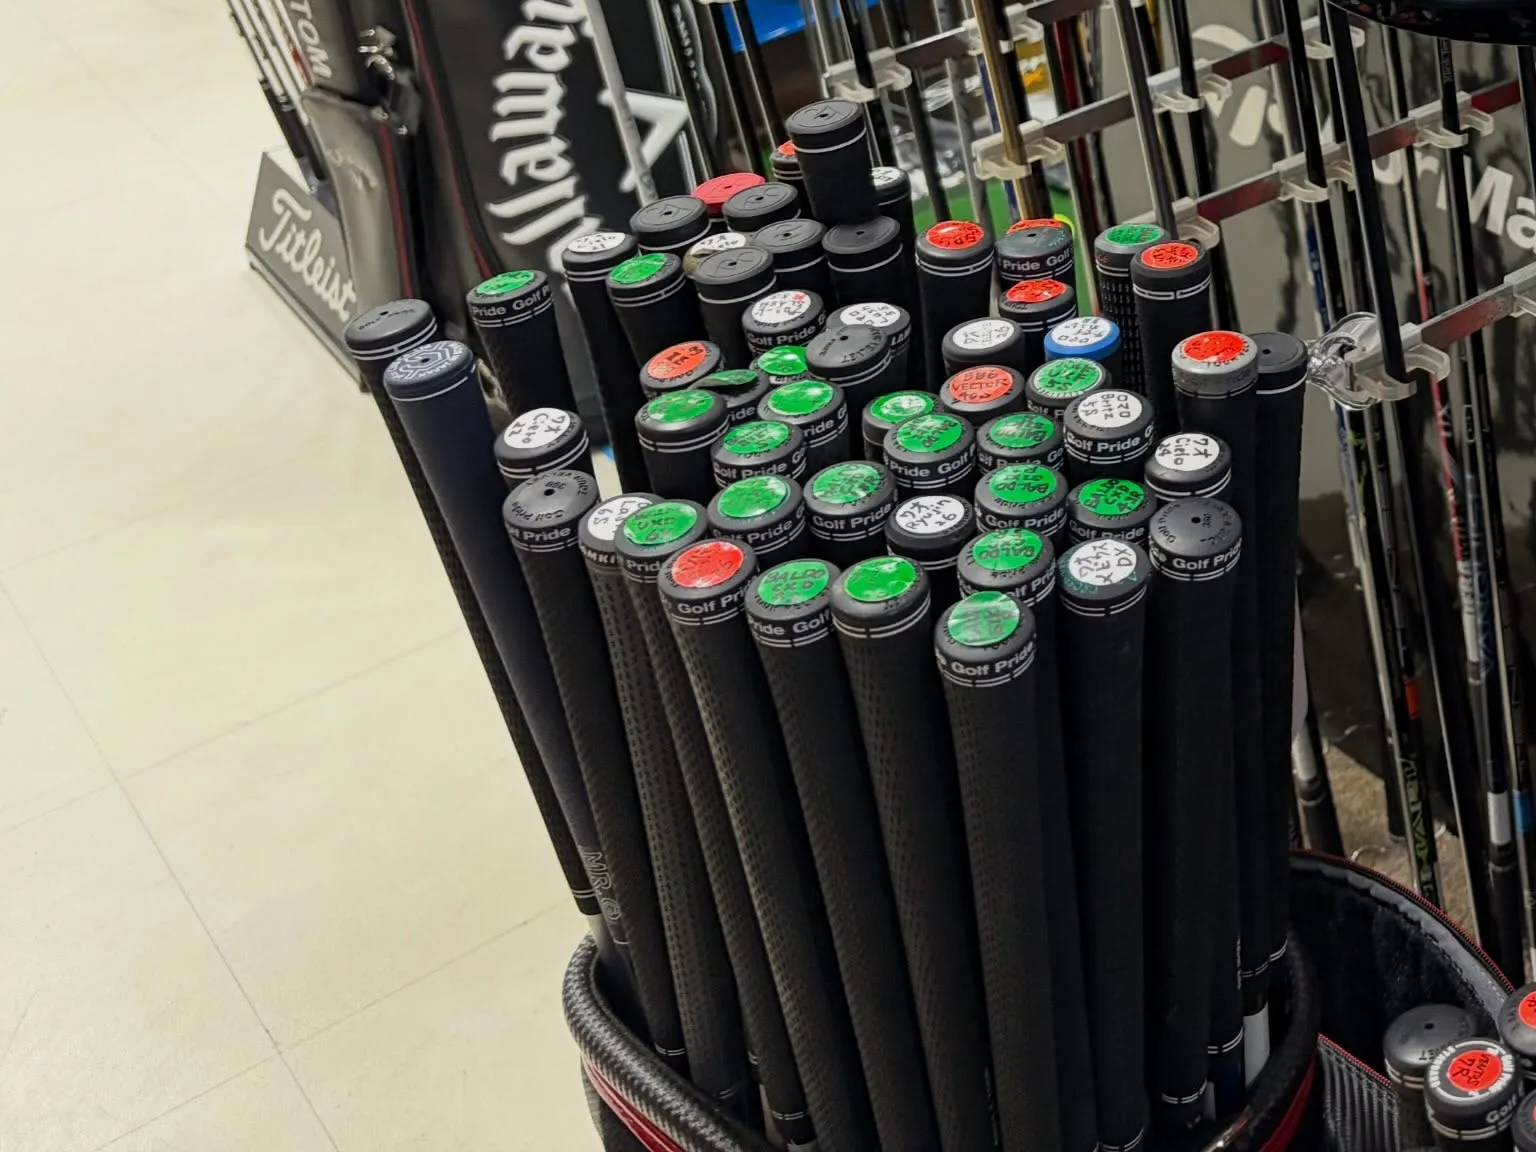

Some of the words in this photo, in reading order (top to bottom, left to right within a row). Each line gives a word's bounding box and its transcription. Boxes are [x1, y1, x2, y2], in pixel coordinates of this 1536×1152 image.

[258, 185, 358, 324] Titleist
[1002, 259, 1040, 272] Pride
[512, 290, 543, 311] Golf
[776, 325, 816, 345] Pride
[729, 405, 756, 421] ride
[803, 416, 834, 437] ride
[1097, 438, 1140, 452] Pride
[889, 462, 930, 477] Pride
[937, 454, 969, 475] Golf
[812, 515, 847, 530] Golf
[851, 503, 892, 528] Pride
[986, 512, 1020, 529] Golf
[1024, 506, 1064, 529] Pride
[523, 526, 571, 541] Pride
[748, 521, 793, 543] Pride
[626, 559, 662, 573] Prid
[1173, 555, 1209, 571] Golf
[677, 600, 717, 615] Golf
[792, 611, 832, 633] Golf
[952, 662, 989, 676] Golf
[995, 641, 1034, 672] Pride
